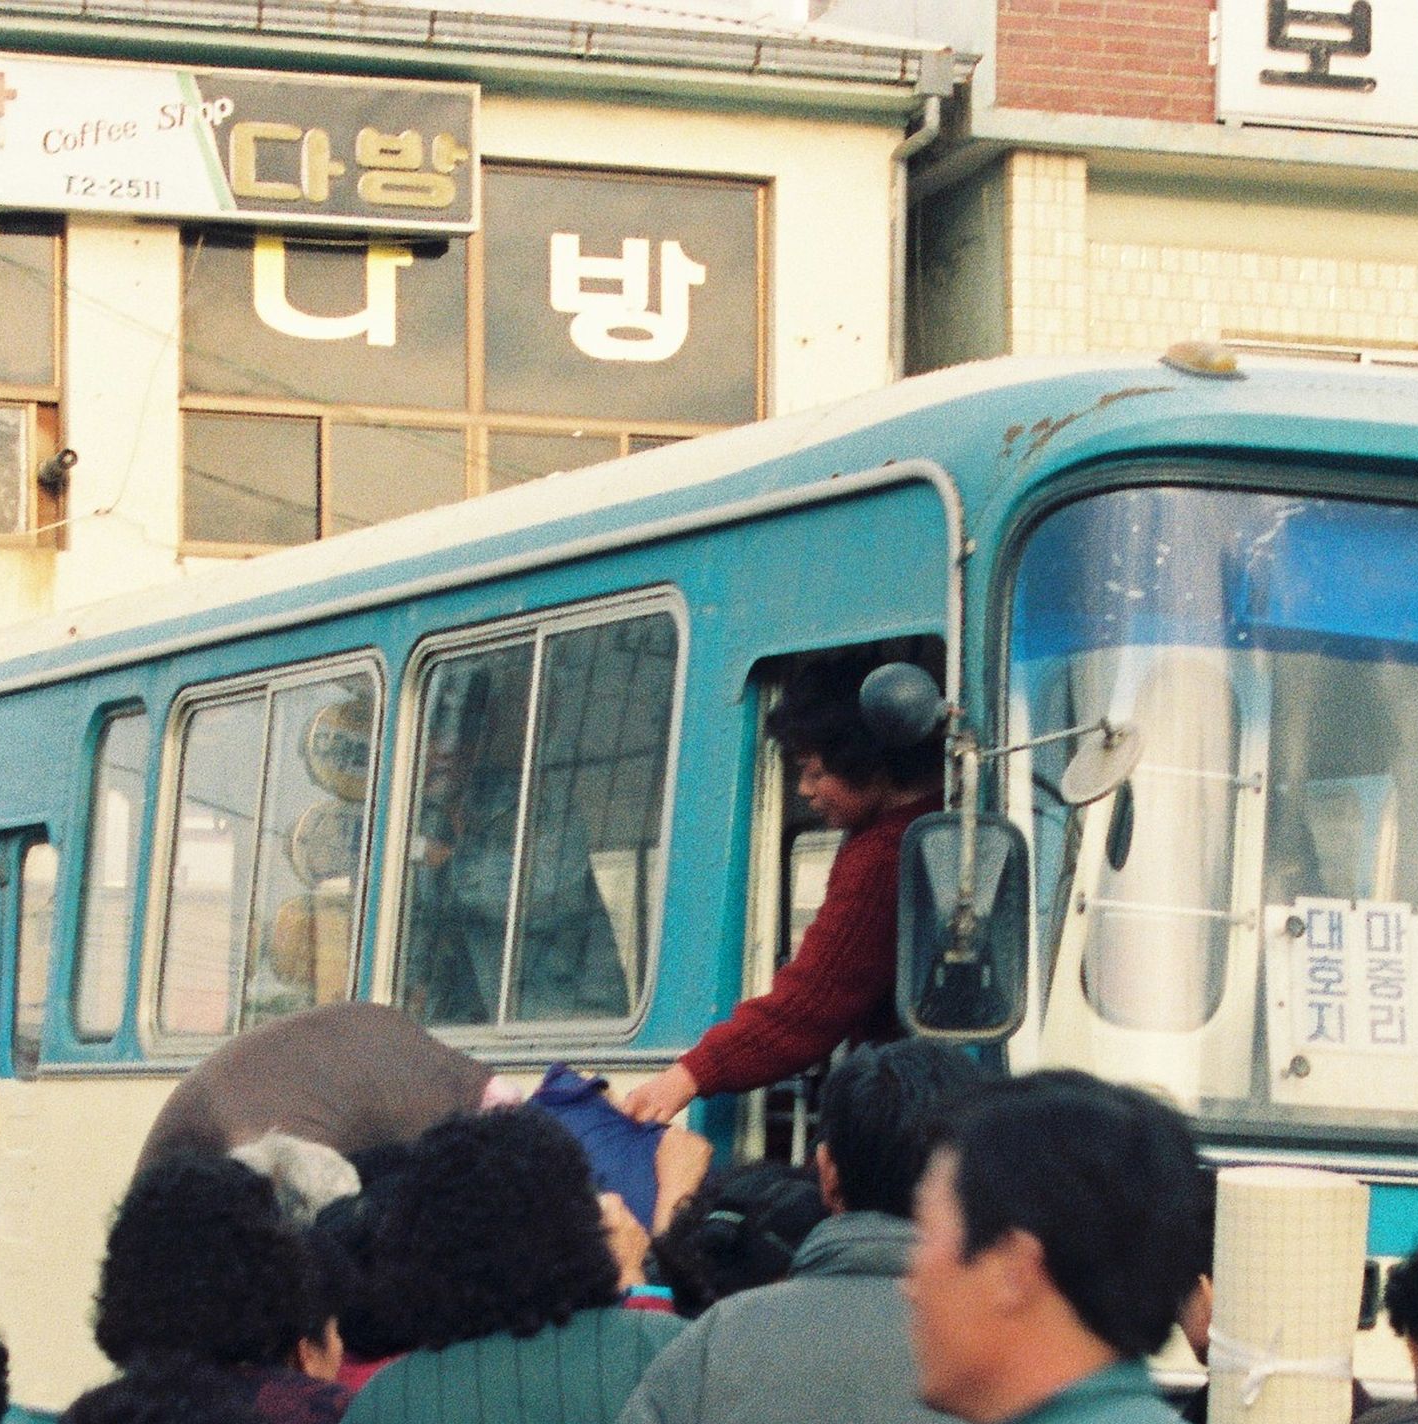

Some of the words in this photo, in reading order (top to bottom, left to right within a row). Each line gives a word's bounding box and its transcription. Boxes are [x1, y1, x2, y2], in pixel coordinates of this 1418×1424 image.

[42, 119, 138, 157] Coffee
[227, 120, 470, 209] 다방
[1305, 907, 1348, 1044] 대호지
[1365, 910, 1407, 1045] 마중리
